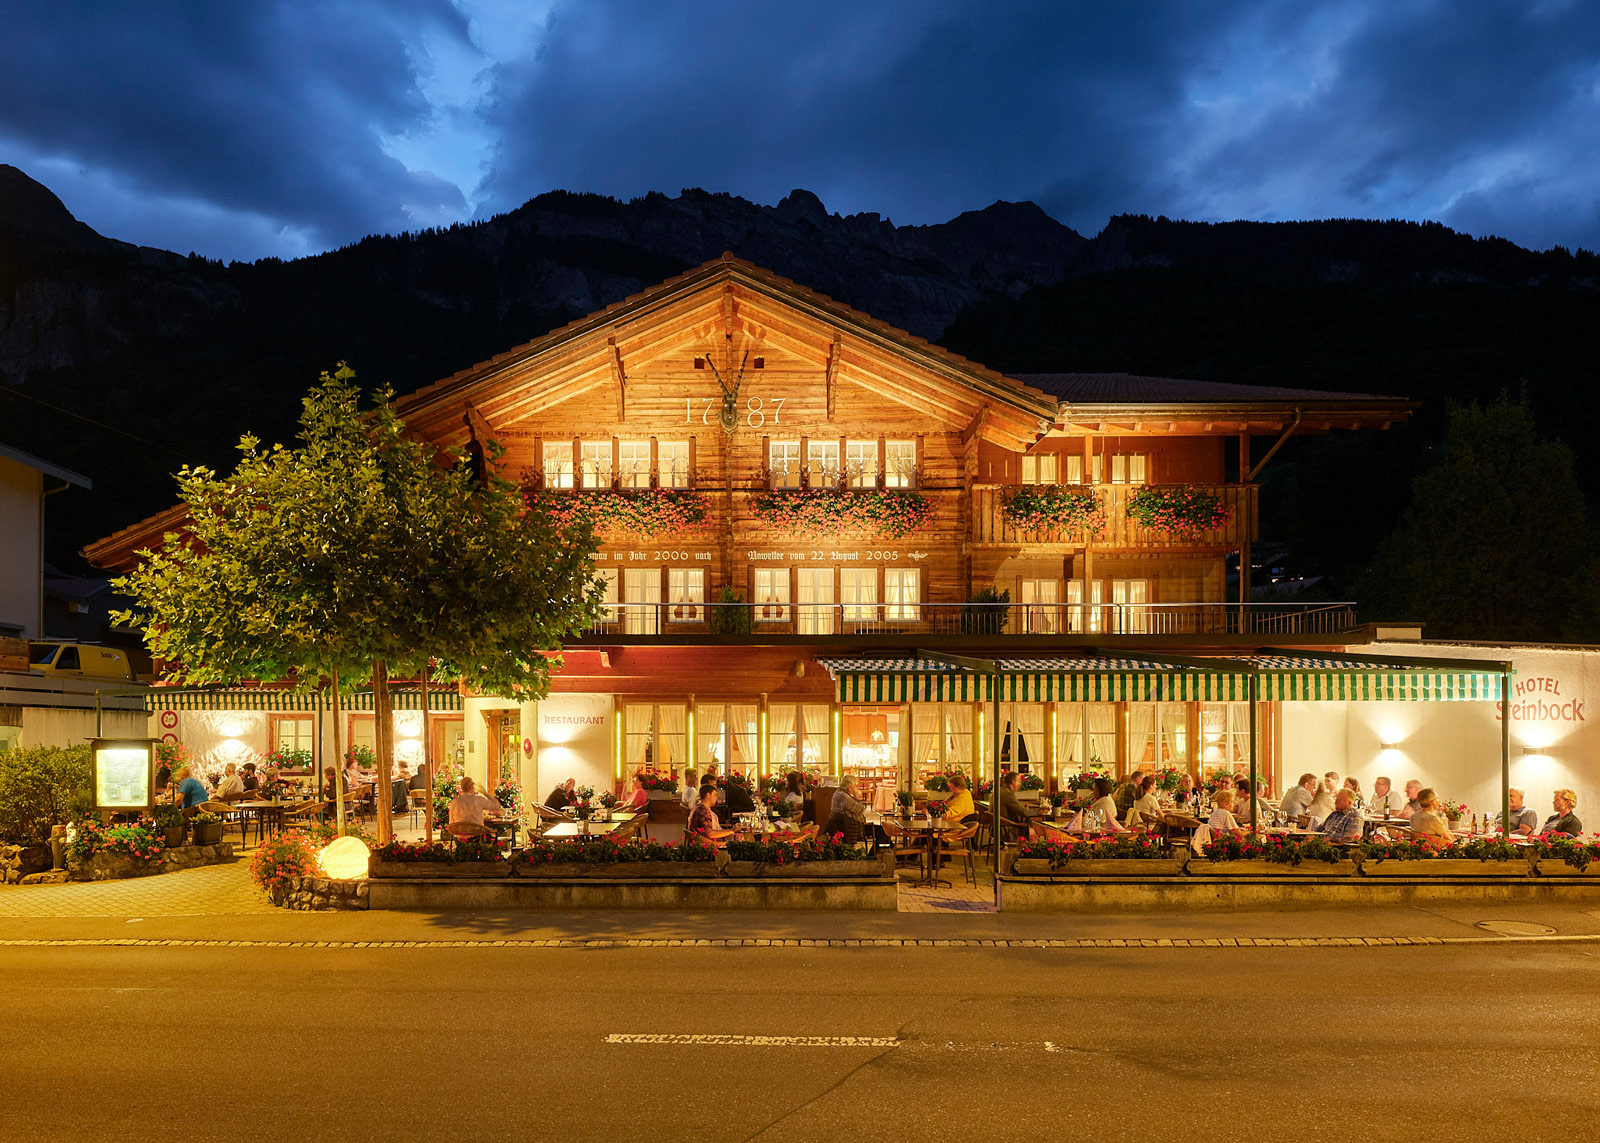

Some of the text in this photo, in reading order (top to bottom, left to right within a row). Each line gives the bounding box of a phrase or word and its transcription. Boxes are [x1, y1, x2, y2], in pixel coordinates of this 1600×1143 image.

[686, 396, 786, 428] 17 87
[614, 551, 623, 561] im
[629, 551, 647, 562] Jahr
[654, 550, 689, 561] 2006
[695, 551, 712, 561] nach
[789, 552, 805, 561] vom
[830, 550, 859, 562] August
[866, 550, 899, 561] 2005
[1515, 677, 1560, 697] HOTEL
[544, 716, 605, 725] RESTAURANT
